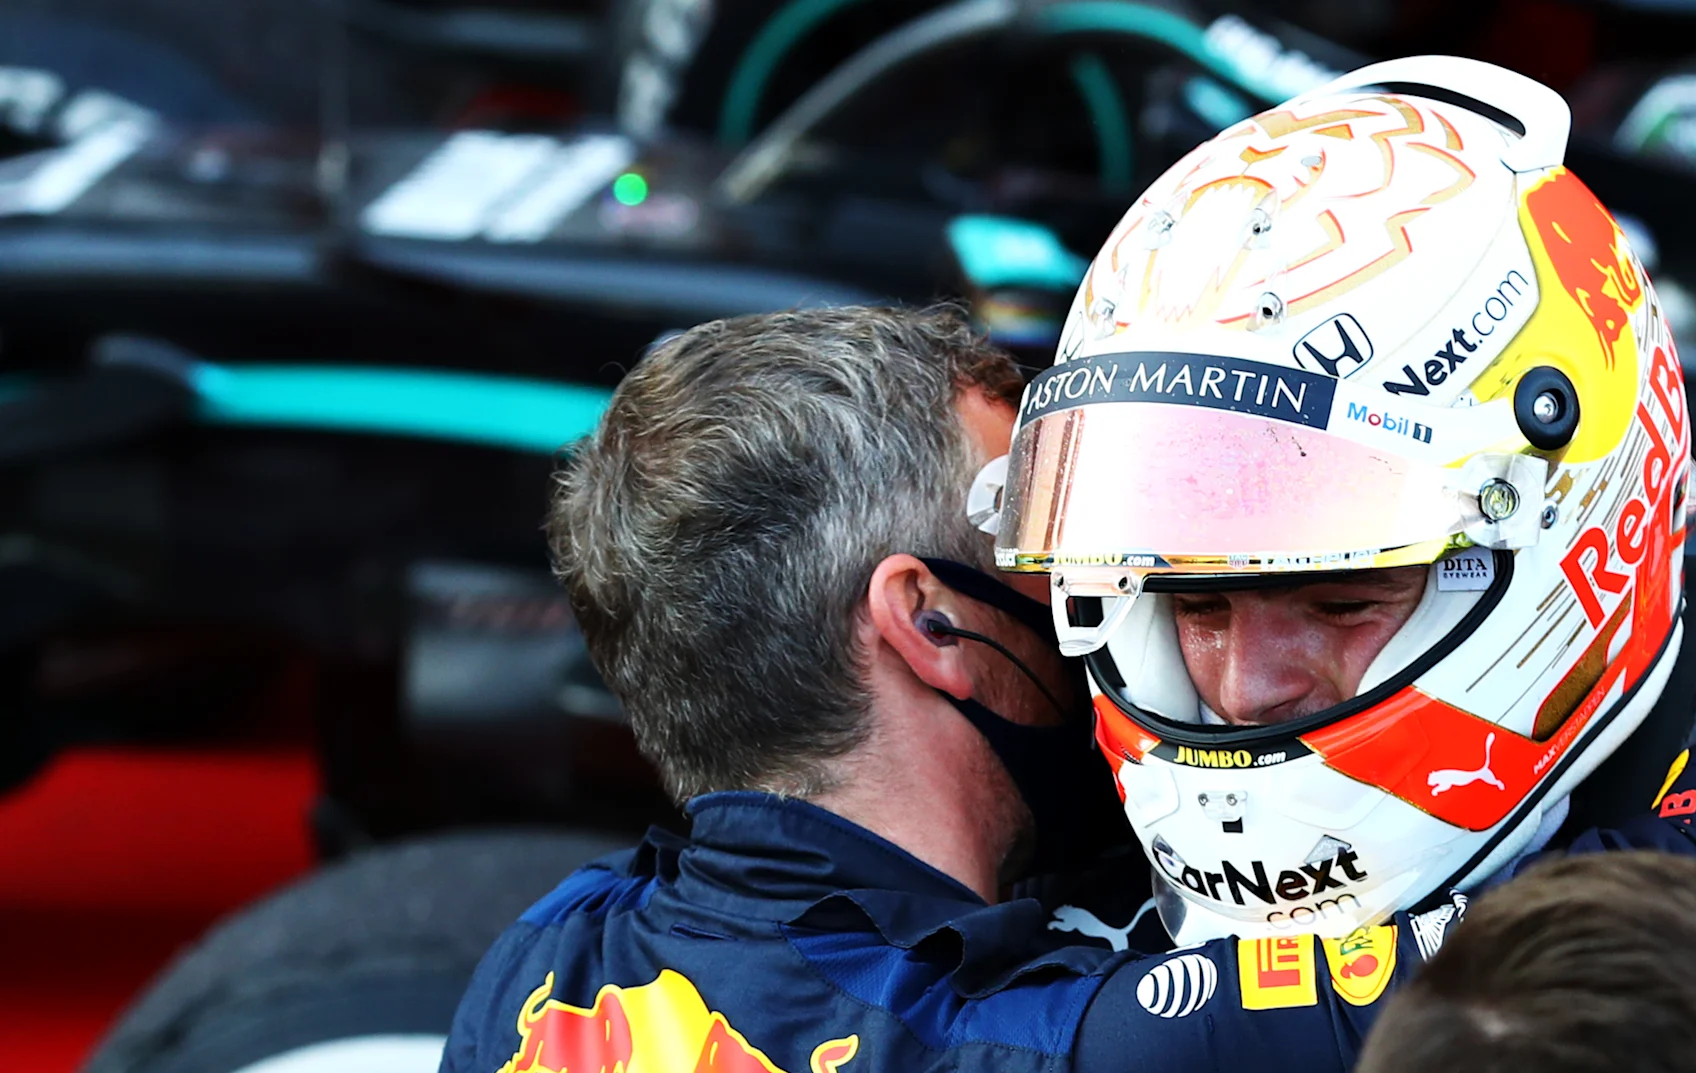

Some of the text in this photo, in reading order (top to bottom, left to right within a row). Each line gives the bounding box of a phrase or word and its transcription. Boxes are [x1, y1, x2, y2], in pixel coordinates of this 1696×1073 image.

[1026, 362, 1307, 416] ASTON MARTIN
[1347, 402, 1409, 436] Mobil
[1559, 400, 1671, 631] Red
[1443, 558, 1487, 571] DITA
